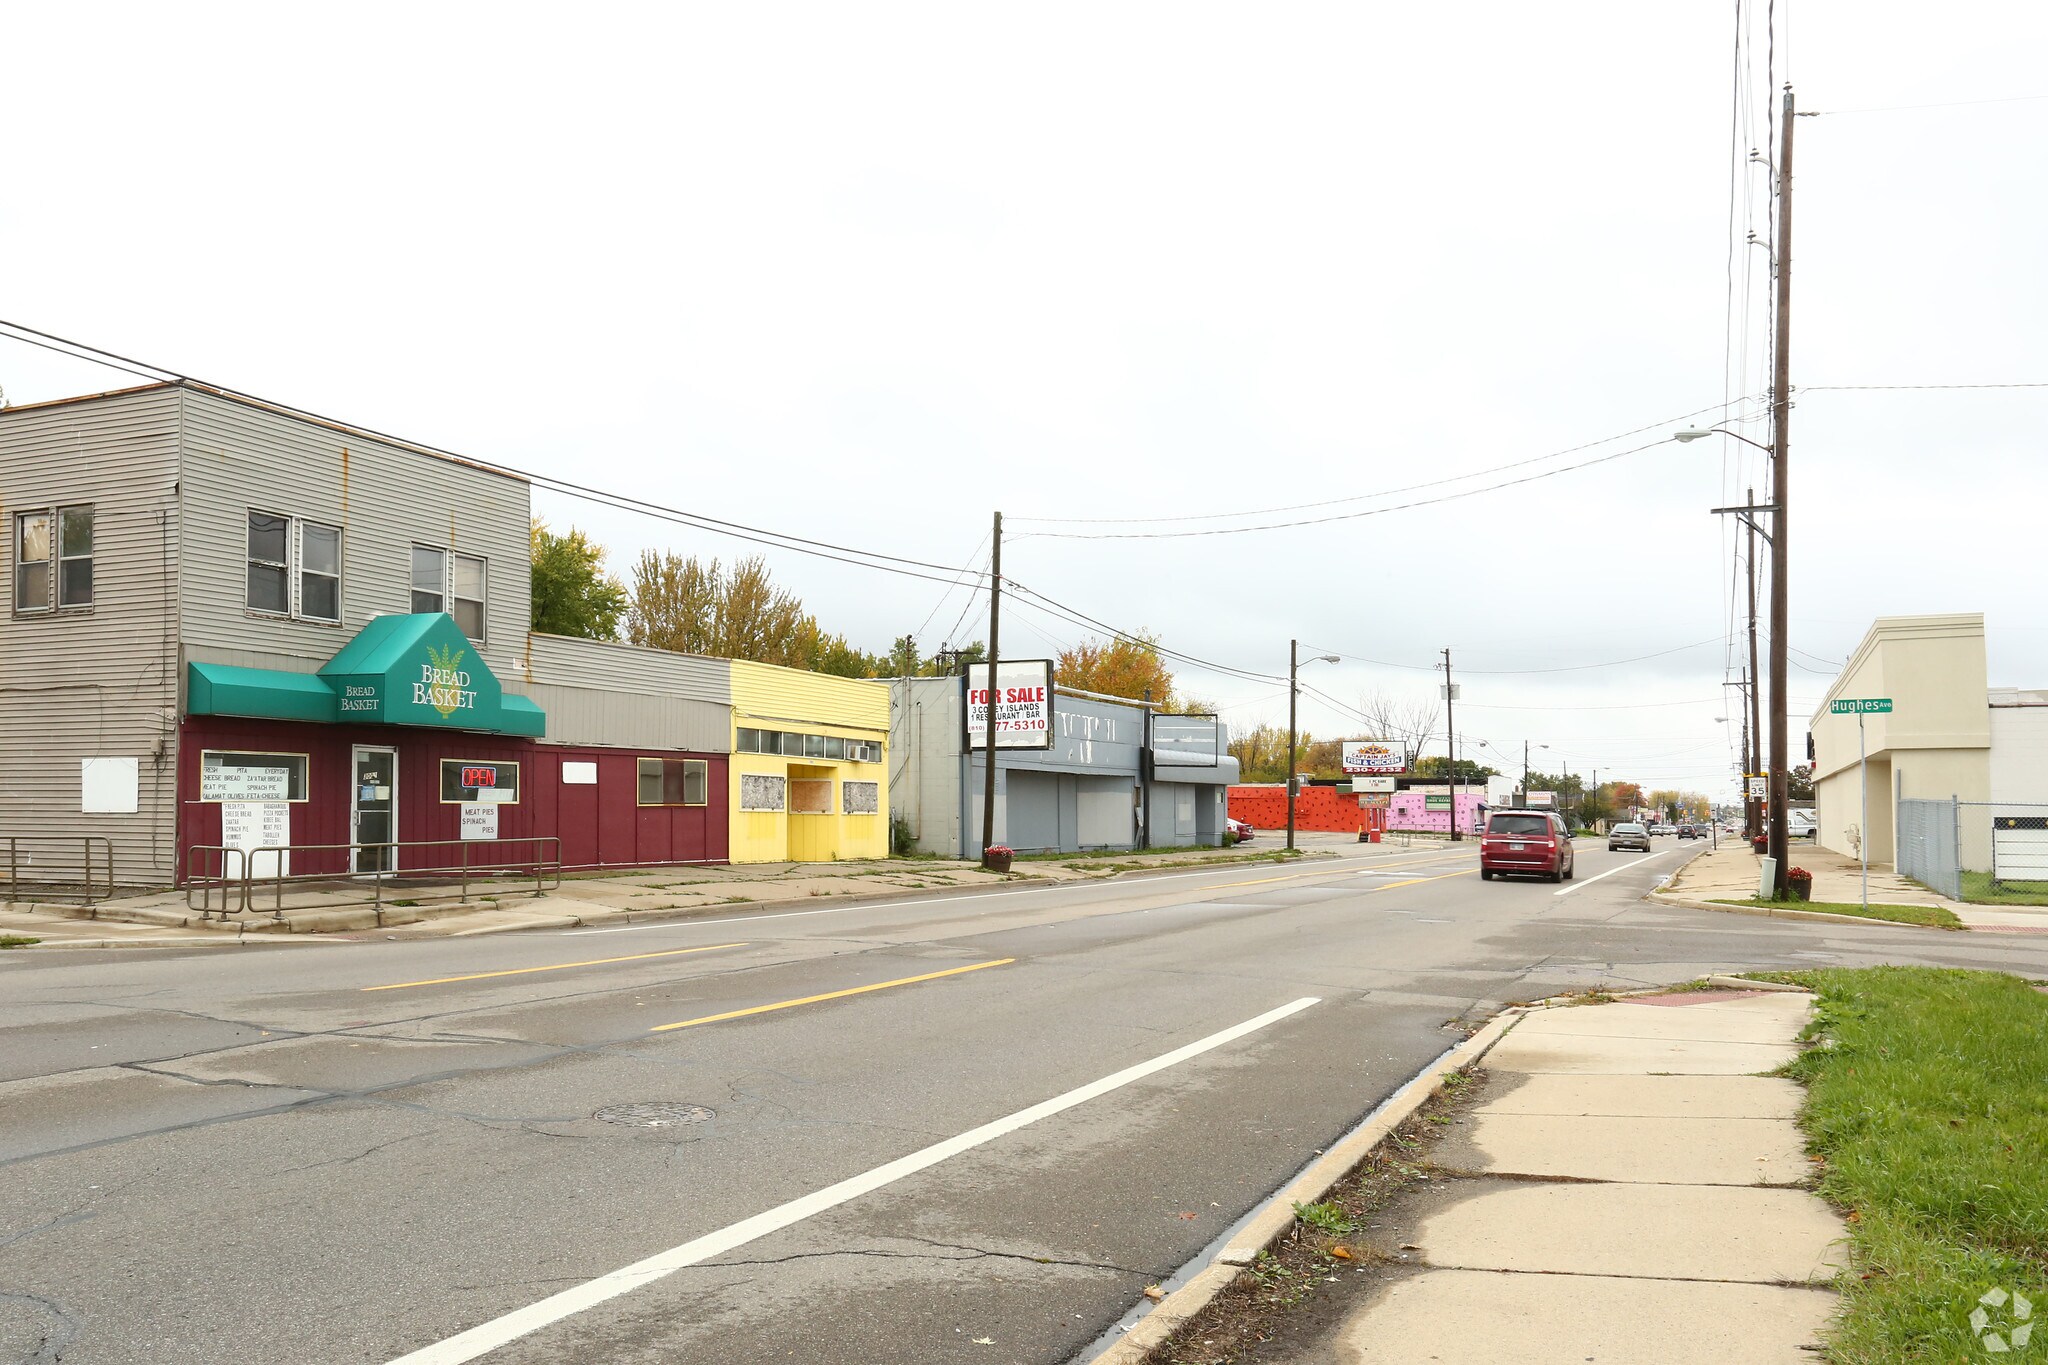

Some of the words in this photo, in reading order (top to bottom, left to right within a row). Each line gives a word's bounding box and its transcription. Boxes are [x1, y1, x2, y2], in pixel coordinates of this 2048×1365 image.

[421, 664, 470, 687] BREAD
[346, 686, 375, 696] BREAD
[412, 682, 477, 709] BASKET
[970, 689, 1001, 704] FOR
[1006, 687, 1045, 703] SALE
[341, 698, 379, 710] BASKET
[972, 706, 977, 714] 3
[978, 705, 1004, 714] COEY
[1006, 703, 1040, 712] ISLANDS
[1831, 700, 1879, 713] Hughes
[976, 712, 1020, 721] RESURANT
[993, 719, 1045, 731] 77-5310
[1369, 757, 1400, 766] CHICKEN
[463, 768, 495, 786] OPEN
[1751, 787, 1765, 795] 35
